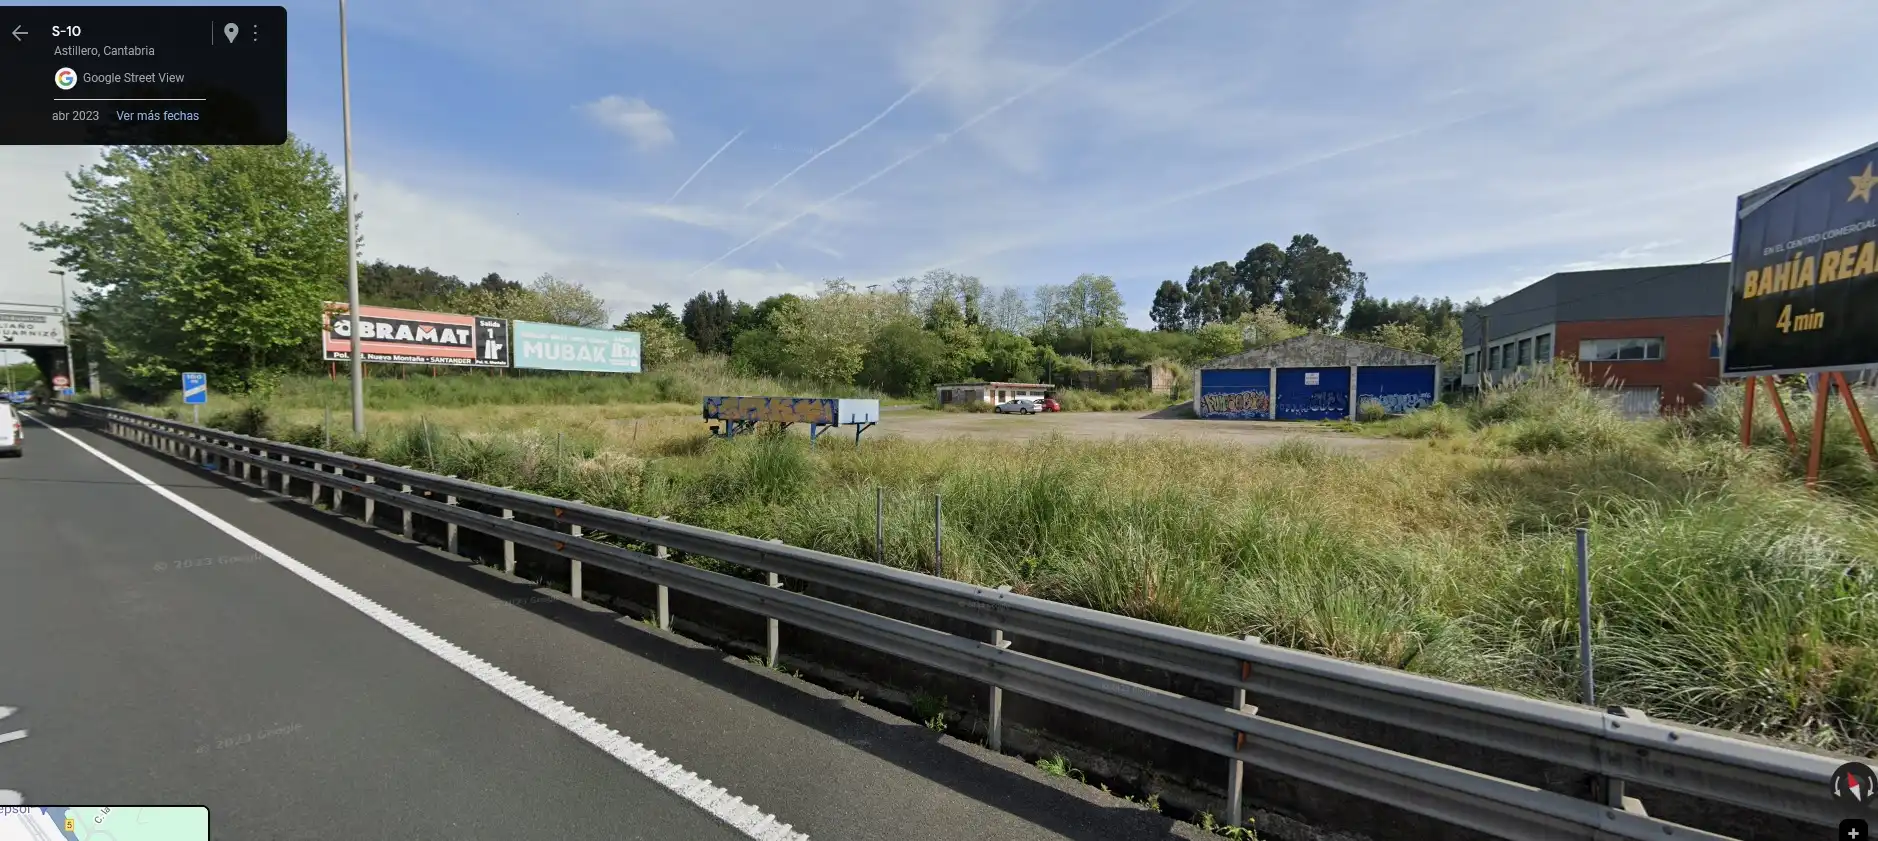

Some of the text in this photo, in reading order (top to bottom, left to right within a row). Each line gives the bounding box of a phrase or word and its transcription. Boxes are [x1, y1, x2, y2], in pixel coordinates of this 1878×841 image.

[1763, 218, 1877, 256] EN EL CENTRO COMERCIAL
[1743, 240, 1878, 300] BAHÍA REA
[334, 319, 470, 345] OBRAMAT
[480, 320, 501, 328] Salida
[1776, 304, 1825, 334] 4 min
[487, 328, 494, 339] 1
[393, 354, 425, 362] Montaña
[430, 356, 472, 364] SANTANDER
